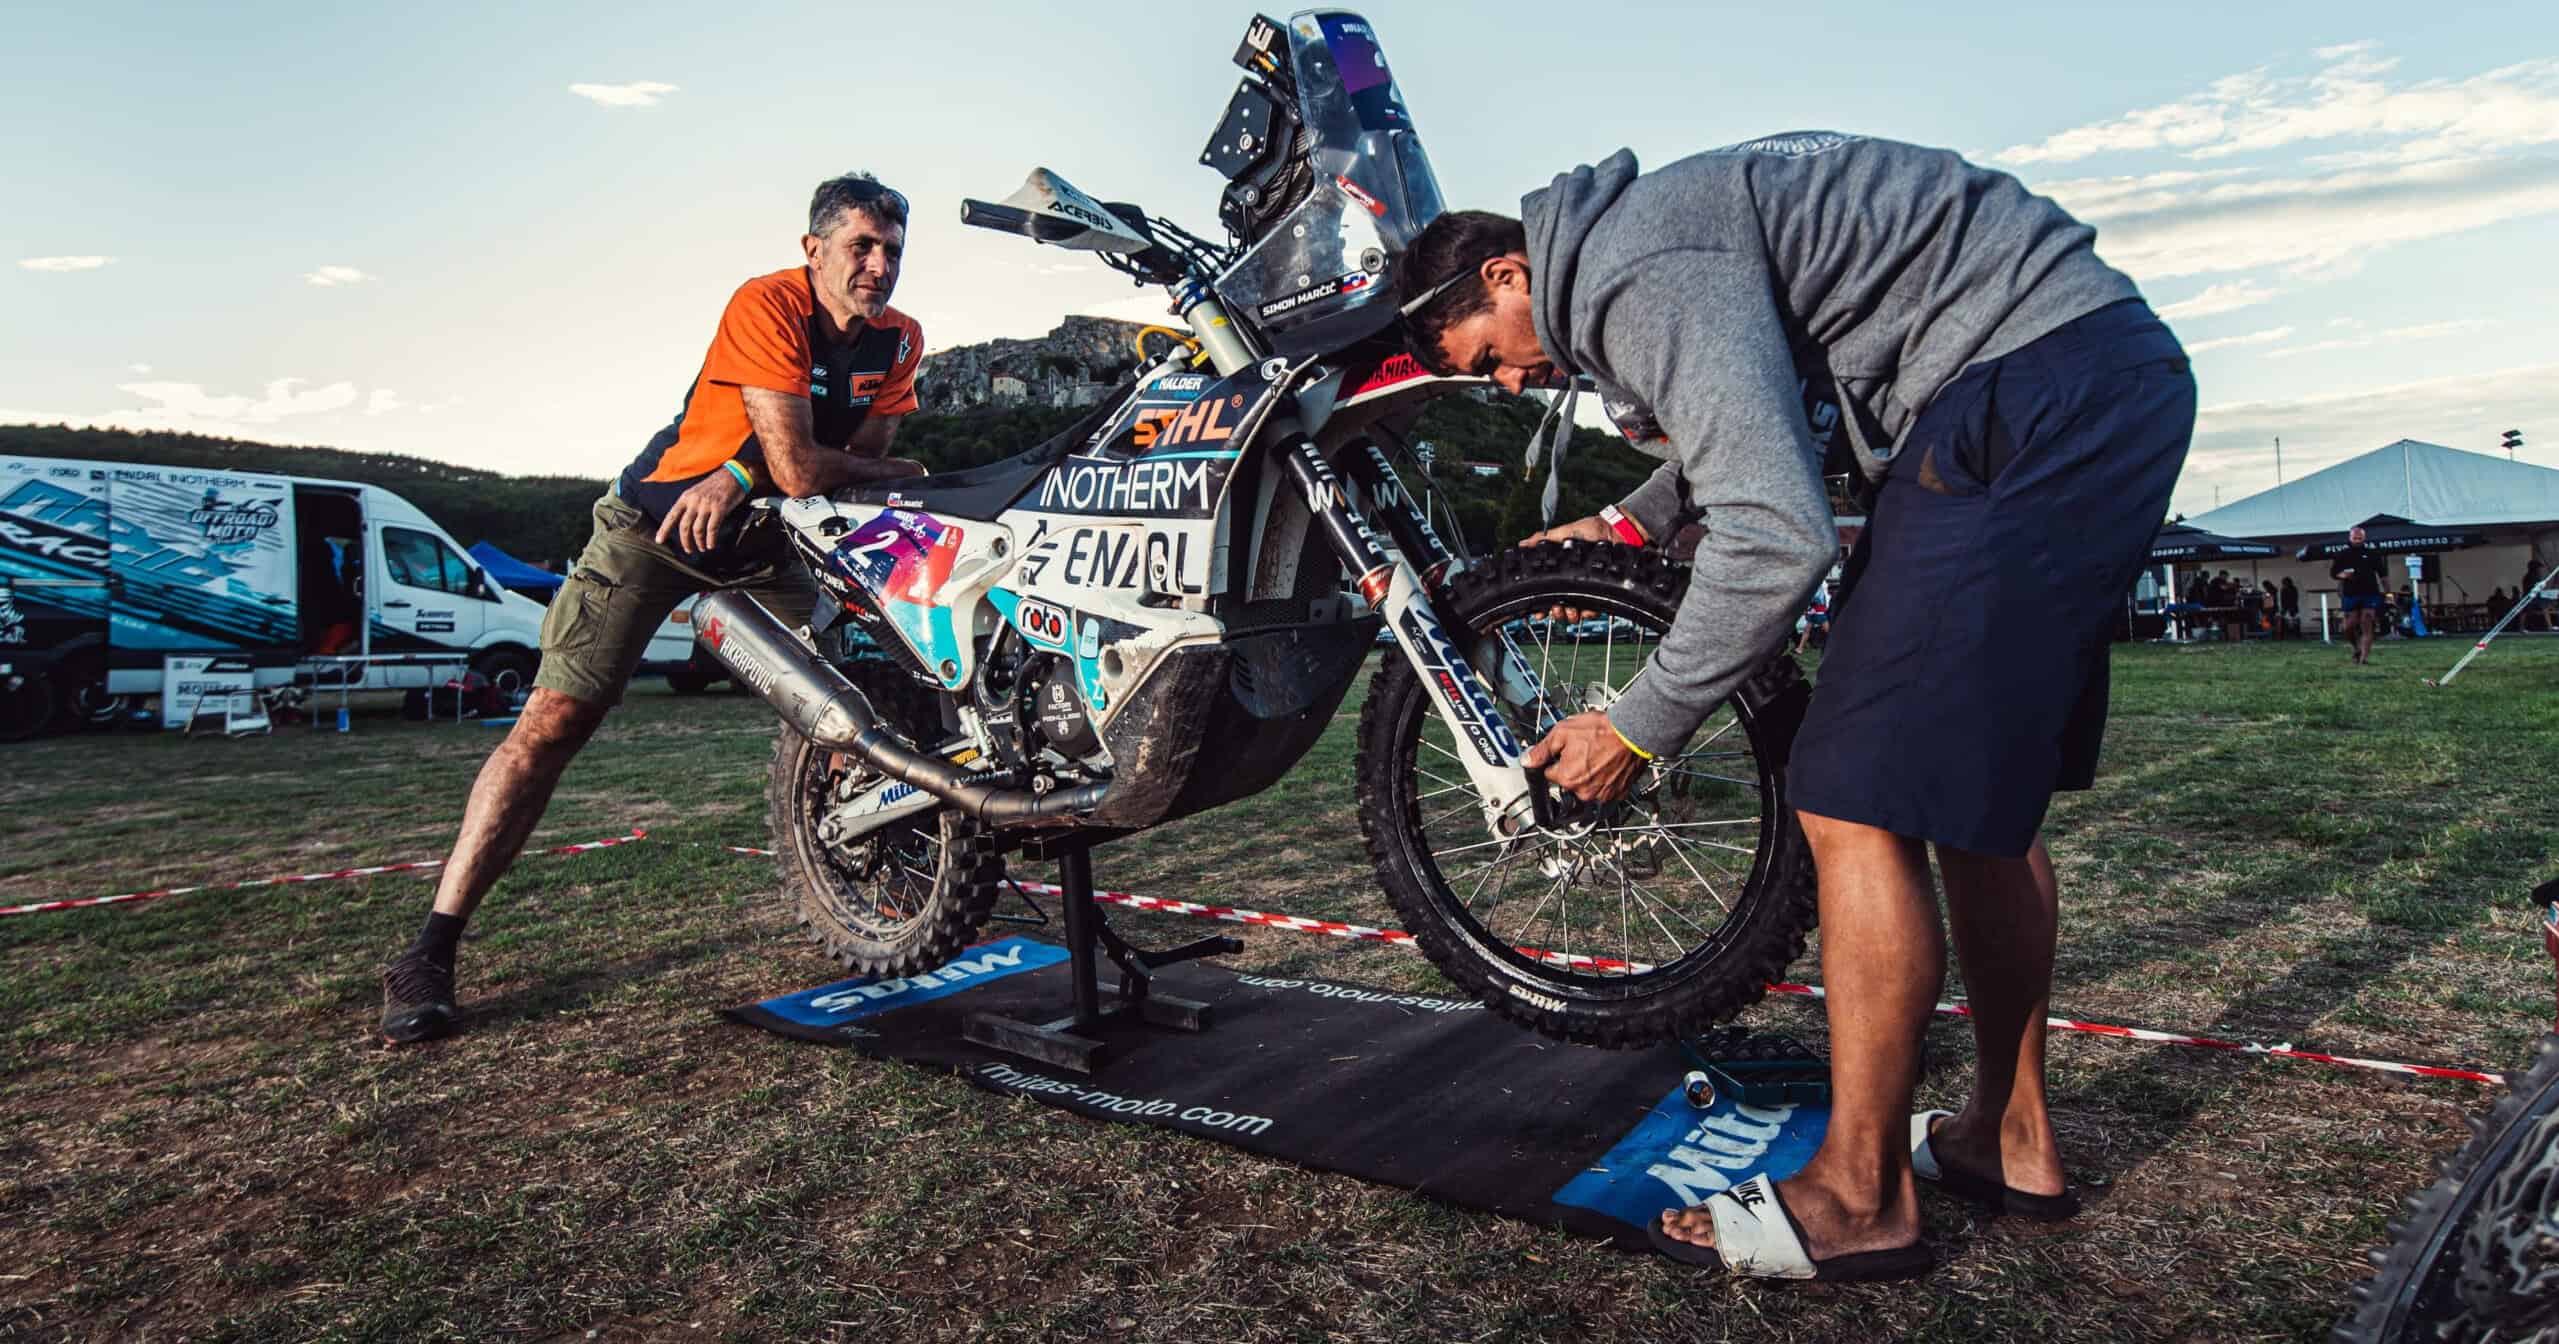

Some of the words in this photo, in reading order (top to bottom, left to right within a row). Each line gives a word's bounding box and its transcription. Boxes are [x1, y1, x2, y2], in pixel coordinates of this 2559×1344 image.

[1047, 201, 1113, 230] ACERBIS
[1262, 298, 1296, 316] SIMON
[1040, 461, 1208, 510] INOTHERM
[849, 530, 899, 569] 2
[810, 944, 1024, 1015] Mitas
[1508, 984, 1568, 1014] Mitas
[979, 1062, 1274, 1136] mitas-moto.com
